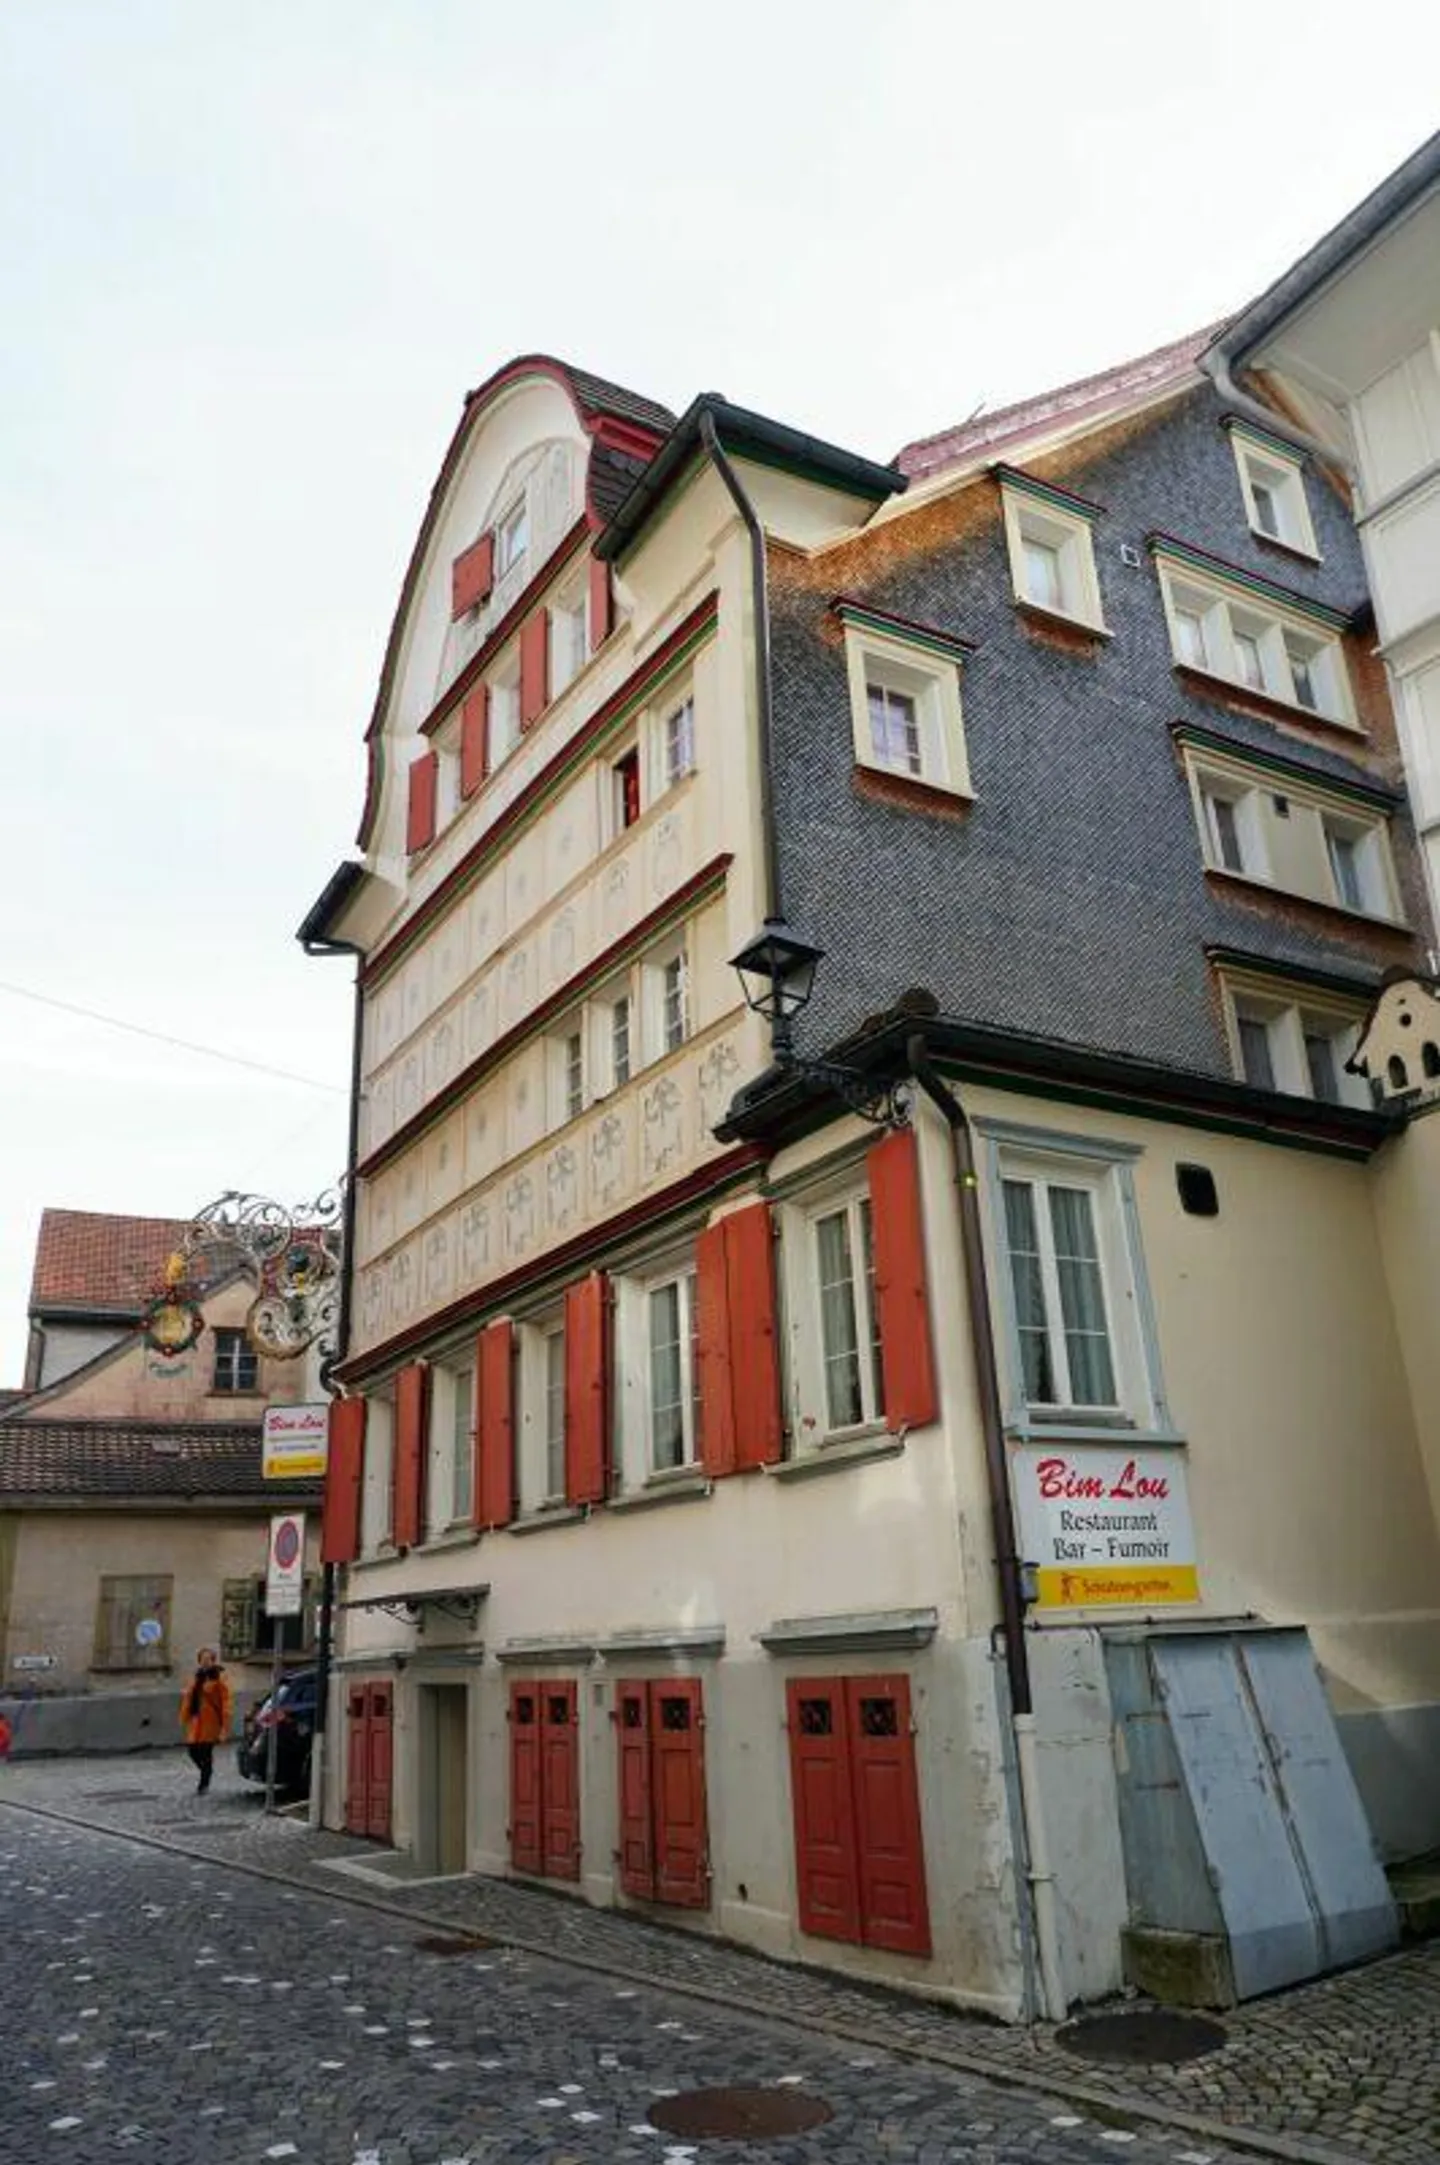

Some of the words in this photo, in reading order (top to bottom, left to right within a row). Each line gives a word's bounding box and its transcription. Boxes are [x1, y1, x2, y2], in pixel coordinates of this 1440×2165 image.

[1037, 1458, 1105, 1498] Bim
[1108, 1459, 1170, 1499] Lou
[1060, 1510, 1158, 1531] Restaurant
[1053, 1538, 1086, 1560] Bar
[1106, 1537, 1170, 1558] Fumoir
